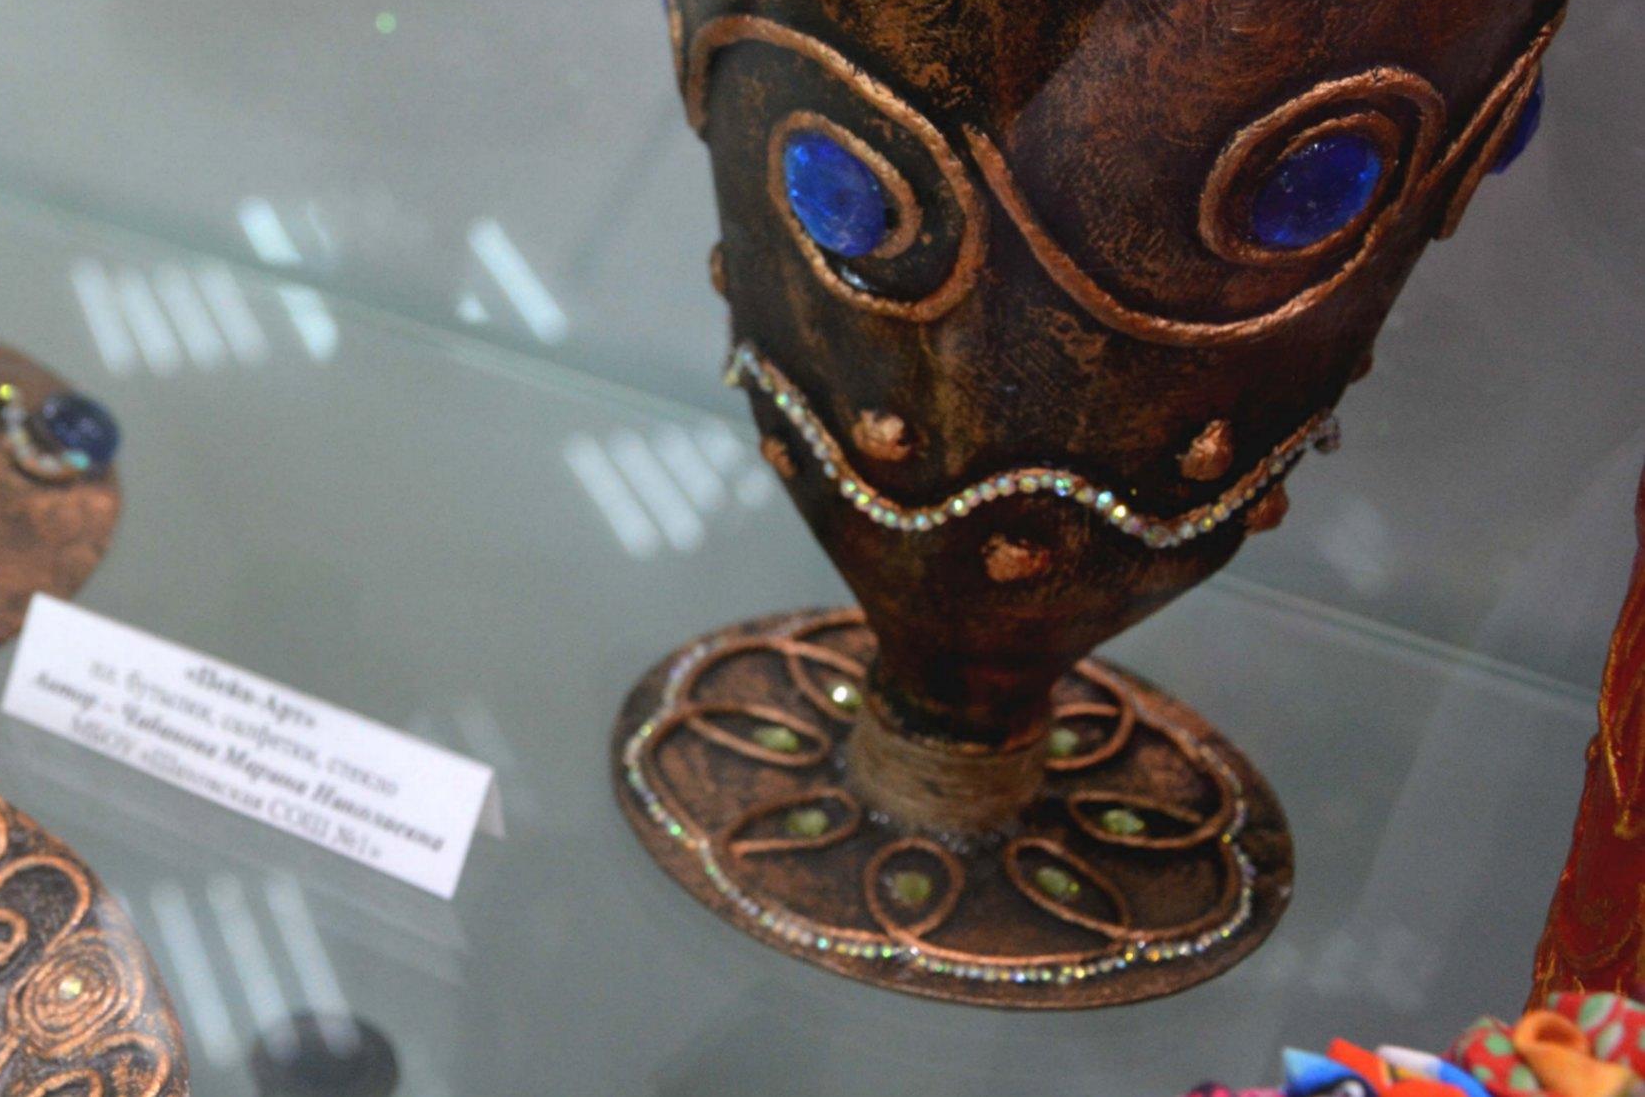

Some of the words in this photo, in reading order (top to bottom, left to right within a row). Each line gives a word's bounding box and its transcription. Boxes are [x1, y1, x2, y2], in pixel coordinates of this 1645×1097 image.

[34, 672, 98, 711] Автор
[225, 746, 309, 794] Марина
[312, 783, 445, 852] Николаевна
[326, 757, 399, 796] стекло
[268, 799, 330, 838] СОШ
